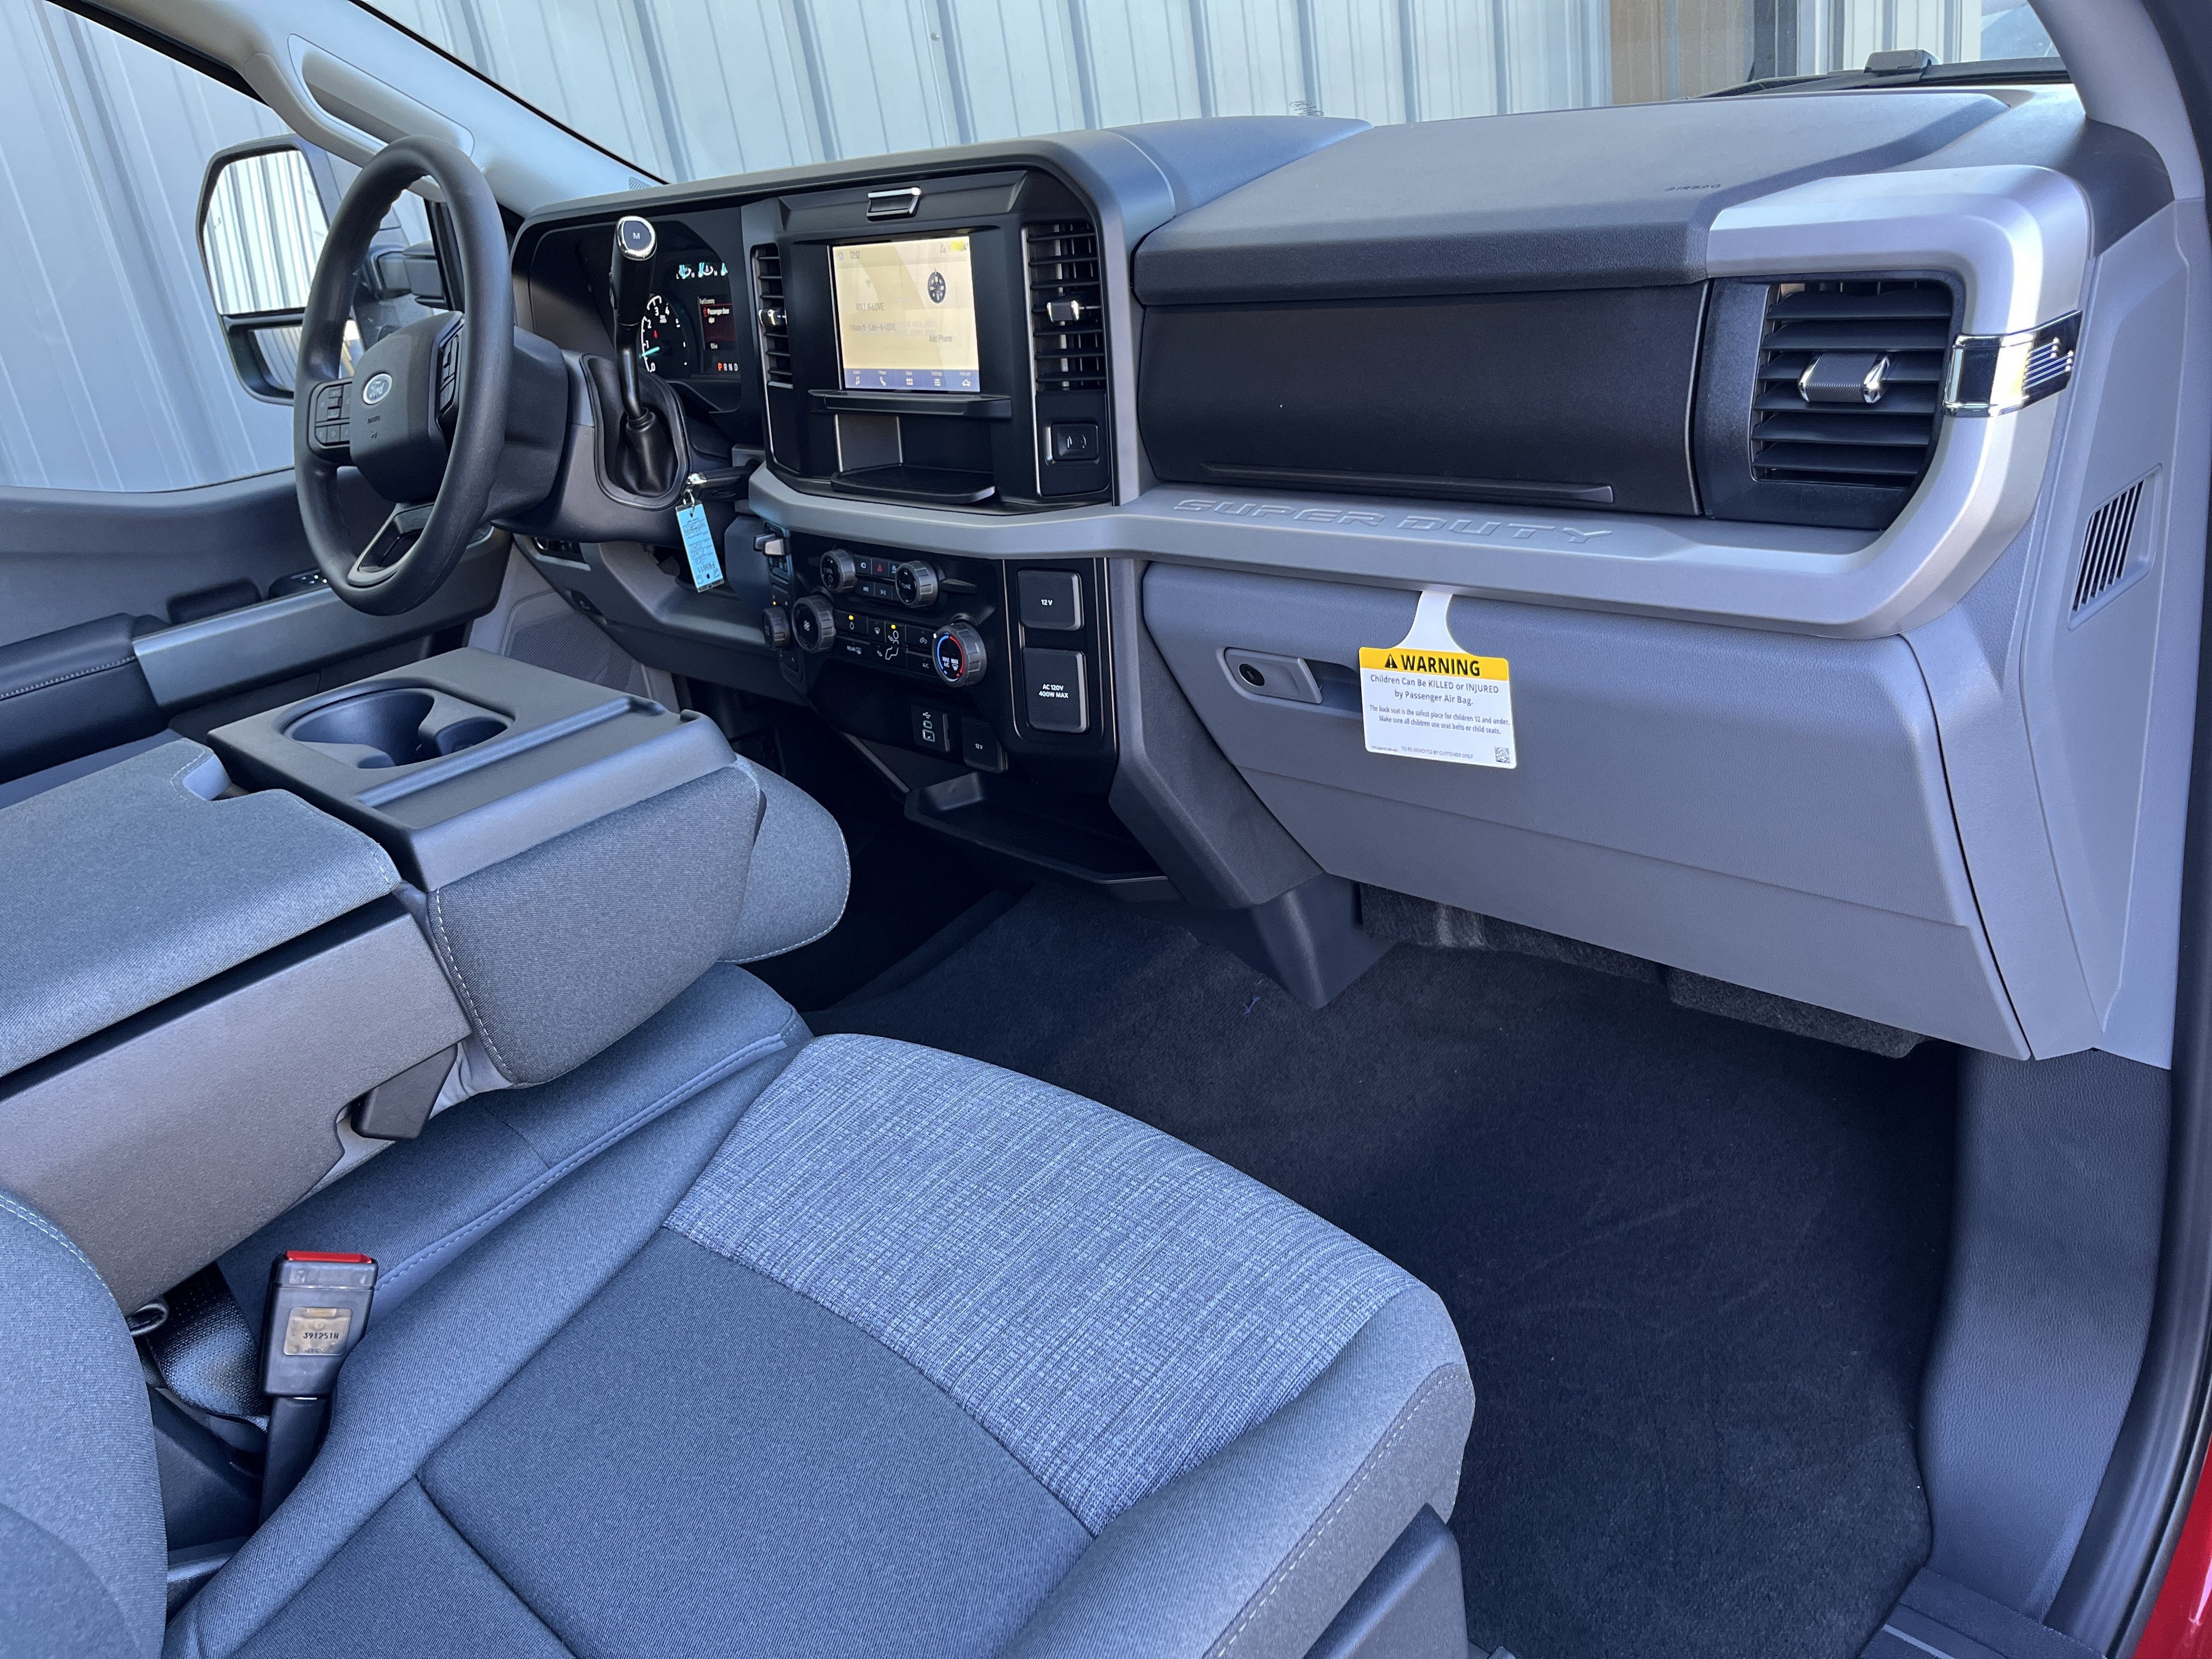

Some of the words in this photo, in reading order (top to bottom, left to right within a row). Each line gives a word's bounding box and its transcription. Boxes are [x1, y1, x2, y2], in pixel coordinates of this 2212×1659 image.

[1173, 499, 1386, 527] SUPER
[1396, 515, 1613, 544] DUTY
[1401, 654, 1480, 676] WARNING
[1370, 674, 1400, 685] Children
[1402, 677, 1415, 686] Can
[1417, 679, 1426, 687] Be
[1428, 680, 1454, 690] KILLED
[1466, 683, 1499, 694] INJURED
[1395, 689, 1403, 699] by
[1405, 691, 1442, 703] Passenger
[1444, 695, 1455, 703] Air
[1457, 696, 1474, 707] Bag.
[1379, 715, 1392, 723] Make
[1410, 719, 1430, 727] children
[1452, 723, 1465, 731] belts
[1431, 711, 1444, 719] place
